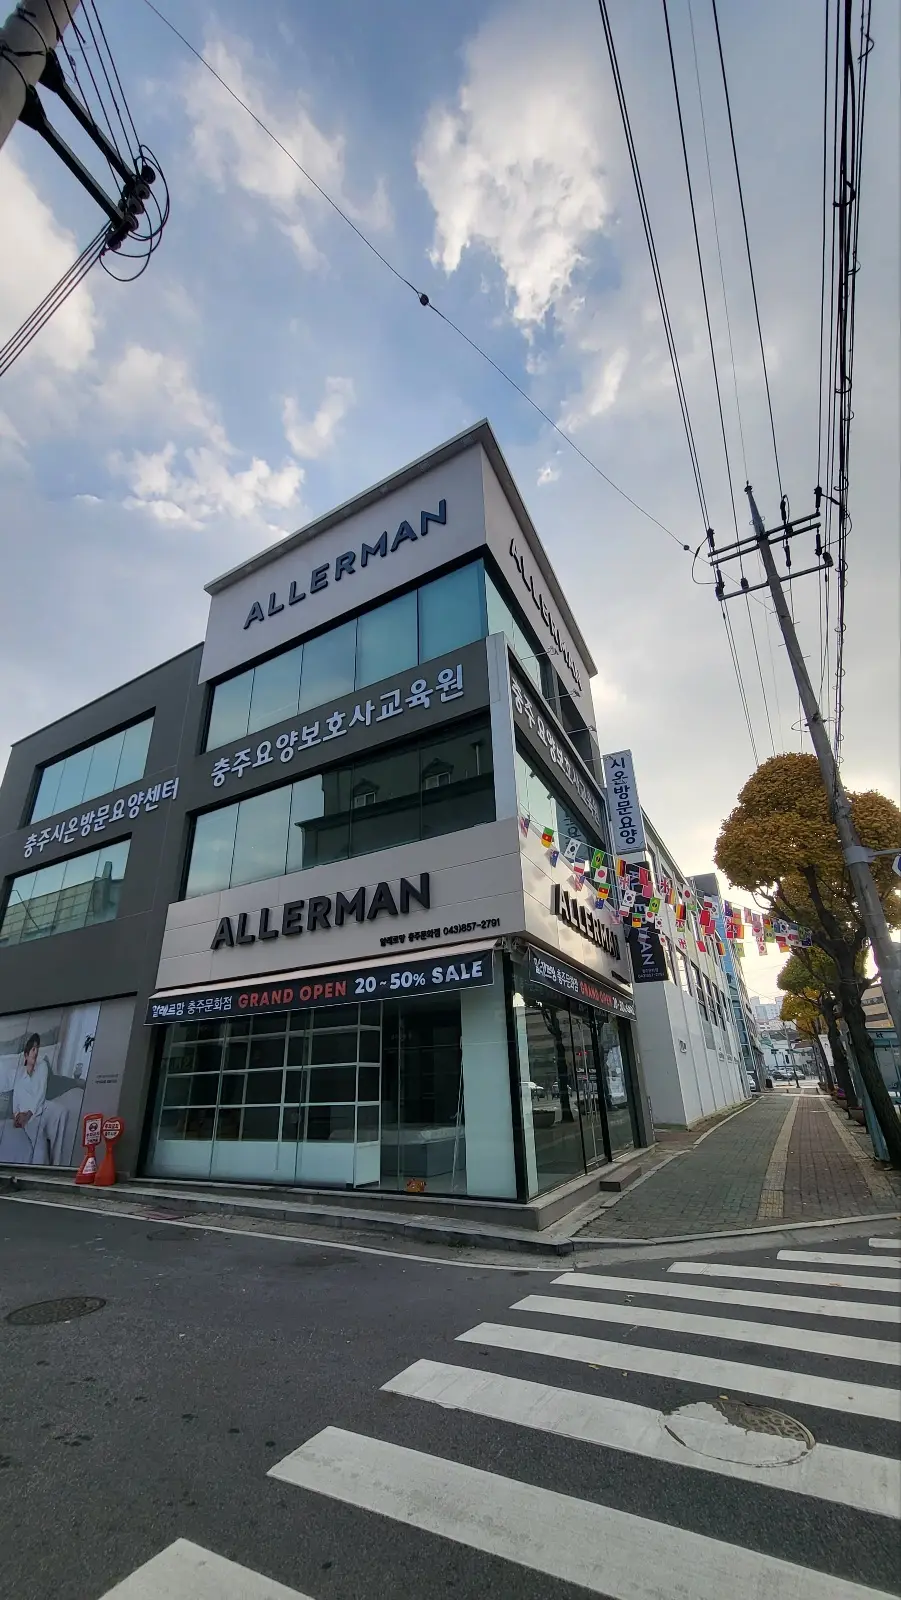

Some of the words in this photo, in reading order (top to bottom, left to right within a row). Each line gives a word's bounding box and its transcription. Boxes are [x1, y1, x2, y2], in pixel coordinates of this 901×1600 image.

[243, 498, 447, 630] ALLERMAN
[210, 664, 465, 788] 충주요양보호사교육원
[610, 757, 638, 845] 시온방문요양
[210, 872, 431, 950] ALLERMAN
[443, 918, 501, 935] 043)857-2791
[152, 1001, 185, 1017] 알레르망
[187, 996, 233, 1014] 충주문화점
[237, 988, 294, 1009] GRAND
[300, 981, 346, 1000] OPEN
[431, 960, 483, 983] SALE
